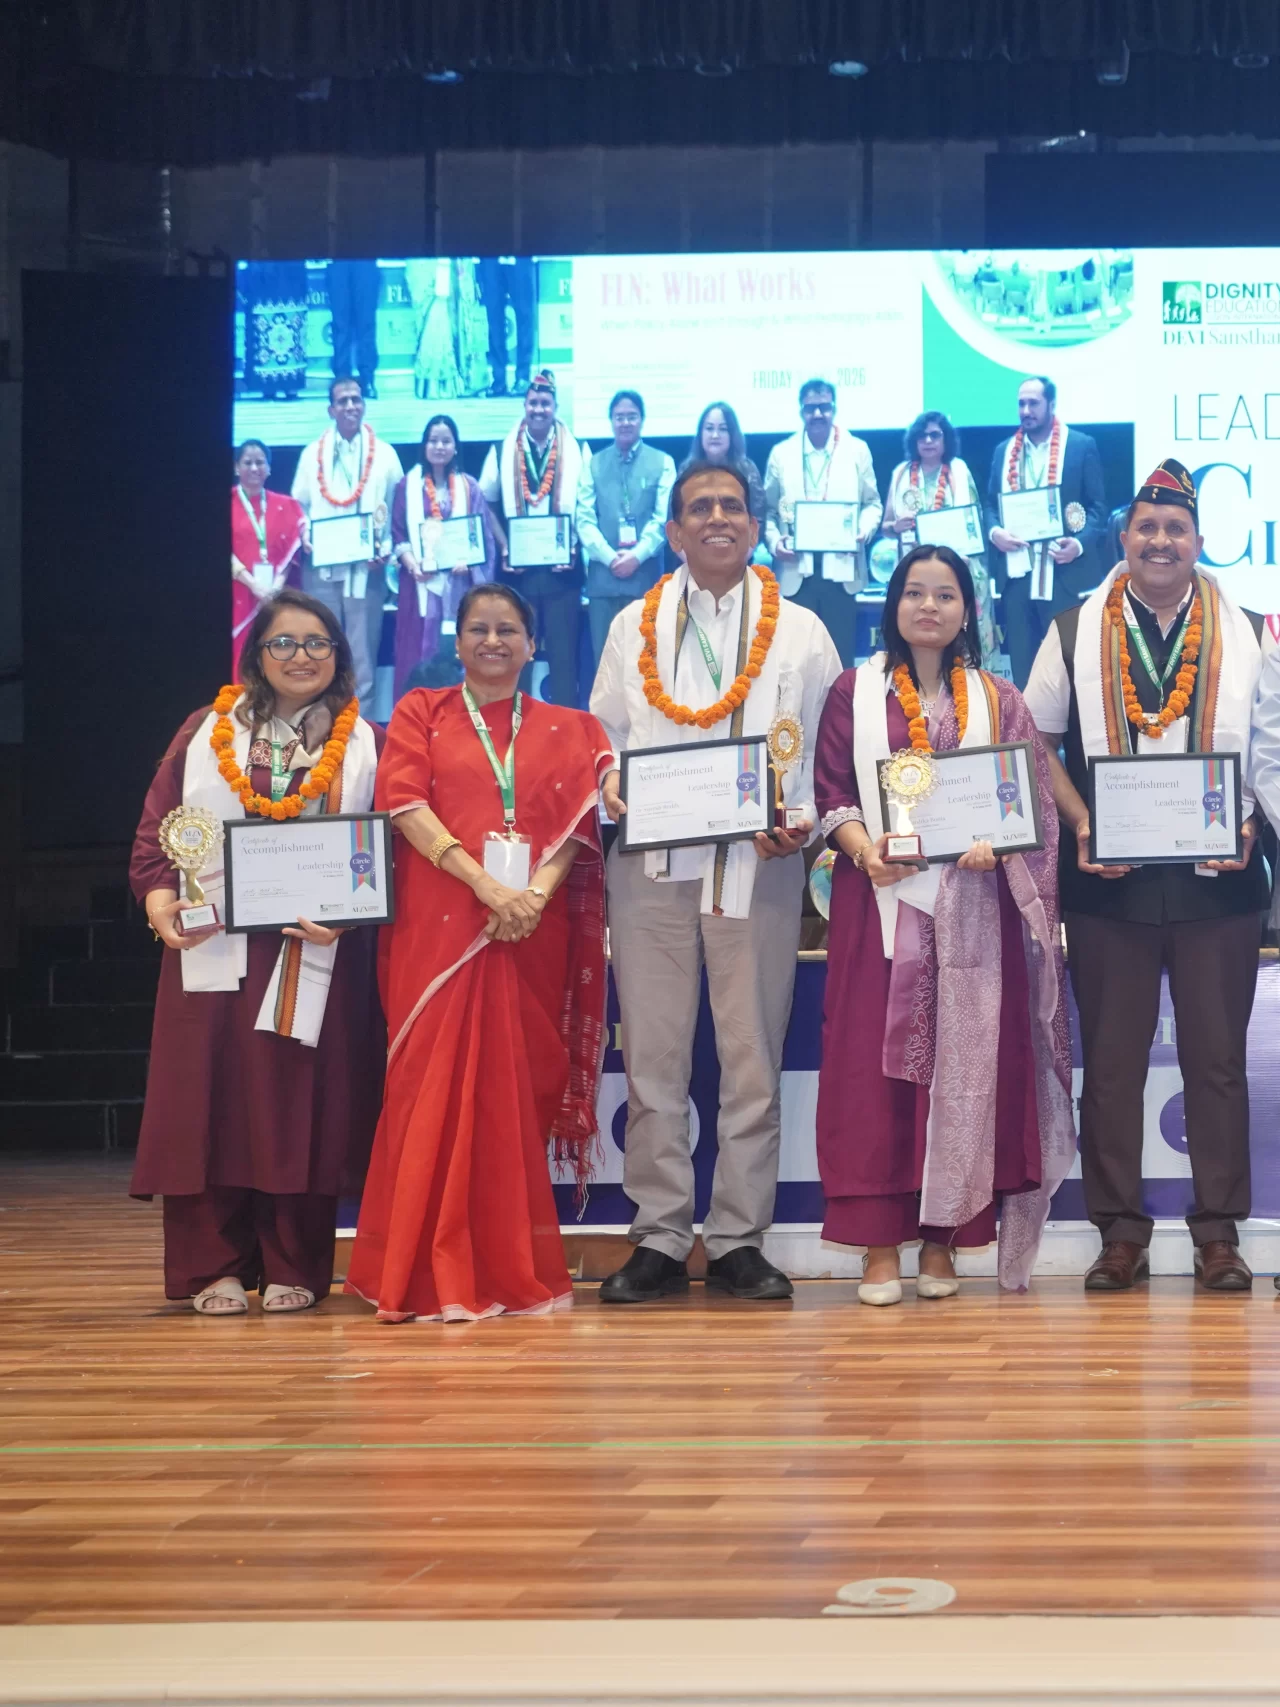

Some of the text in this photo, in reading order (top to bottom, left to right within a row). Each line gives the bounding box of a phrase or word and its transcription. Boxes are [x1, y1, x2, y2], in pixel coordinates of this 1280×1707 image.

[662, 269, 727, 305] What
[736, 267, 816, 304] Works
[752, 367, 866, 389] FRIDAY 2026
[1135, 632, 1153, 671] DEVI SANSTHAN
[1169, 652, 1178, 666] DEVI
[640, 765, 714, 782] Accomplishment
[738, 776, 756, 784] Circle
[688, 780, 732, 793] Leadership
[997, 787, 1016, 795] Circle
[1103, 780, 1180, 791] Accomplishment
[947, 792, 991, 805] Leadership
[1154, 798, 1198, 808] Leadership
[241, 843, 325, 856] Accomplishment
[297, 860, 344, 872] Leadership
[352, 857, 371, 865] Circle
